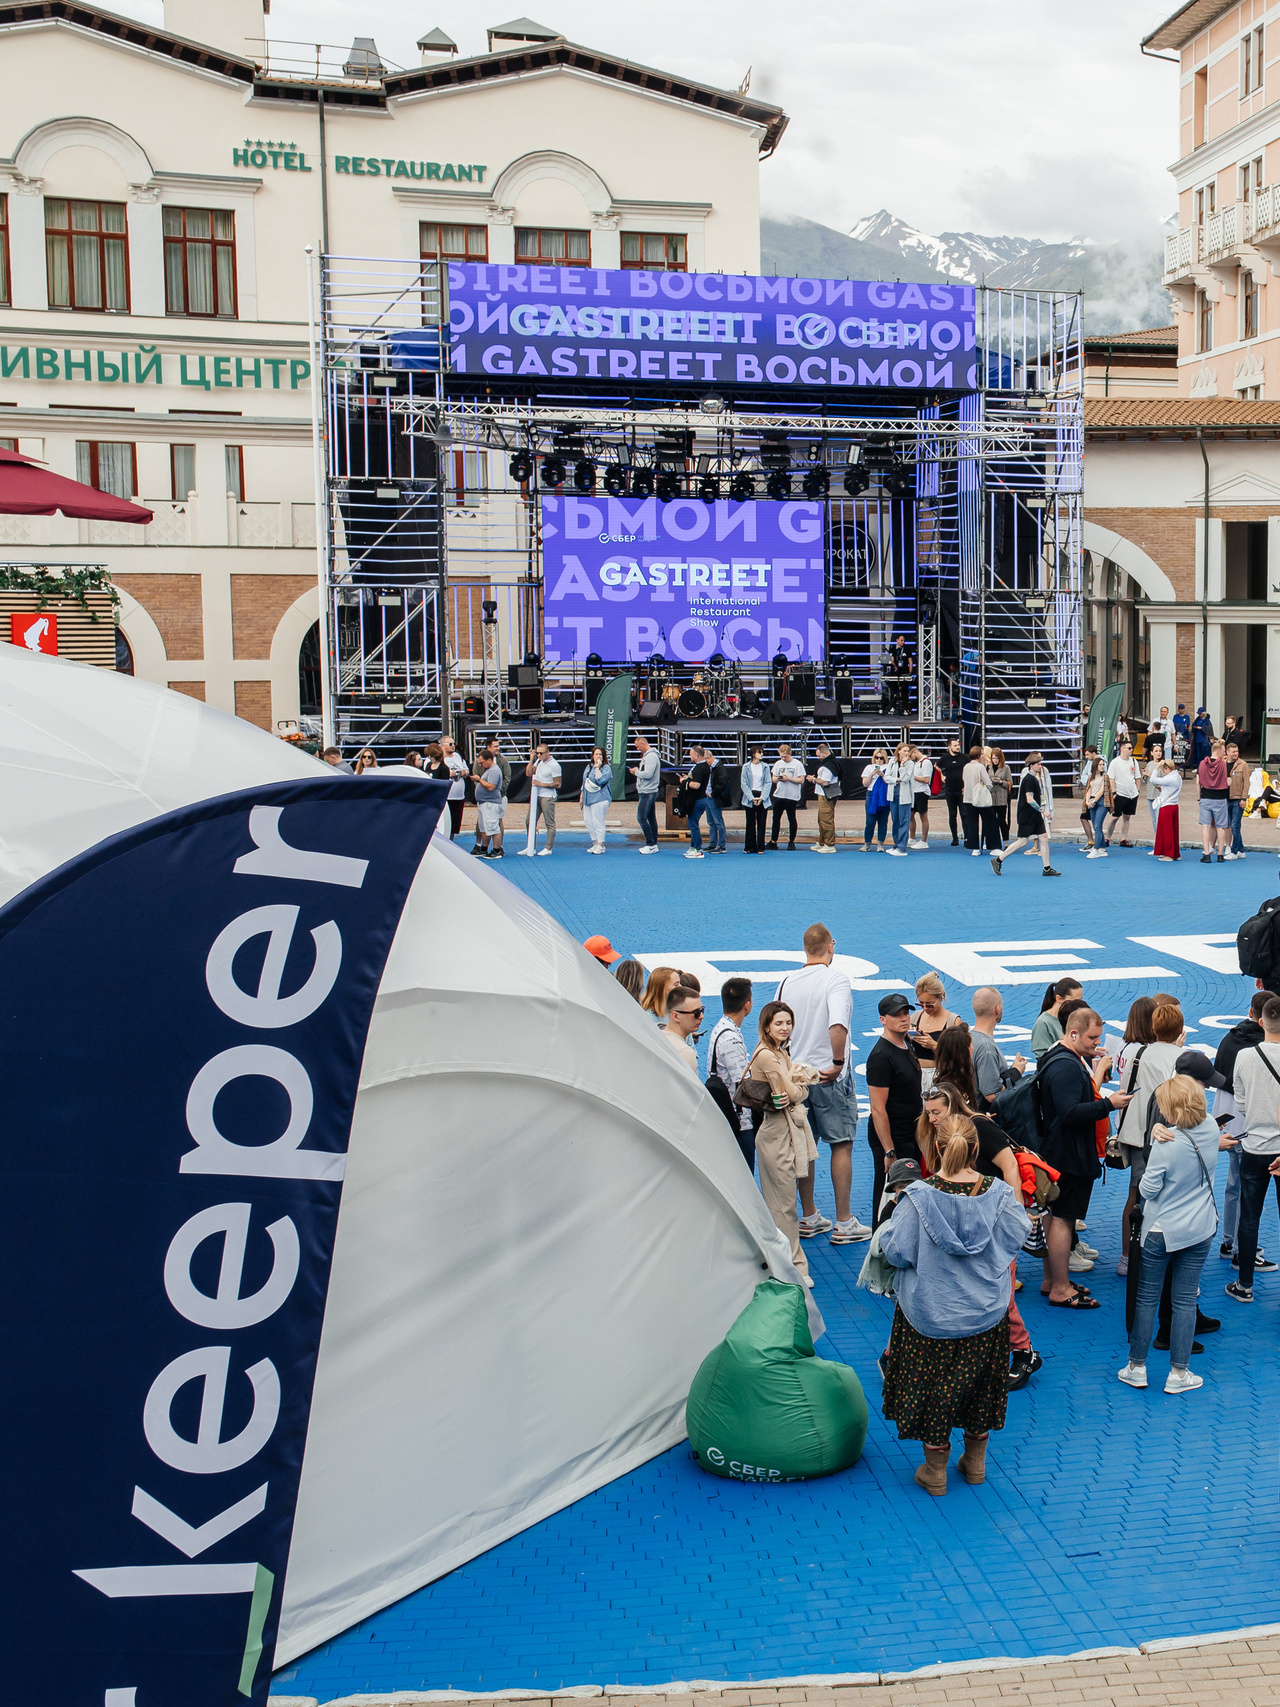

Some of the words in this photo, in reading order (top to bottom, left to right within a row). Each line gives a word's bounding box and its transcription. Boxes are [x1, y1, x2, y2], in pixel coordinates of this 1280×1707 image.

[233, 147, 312, 172] HOTEL
[335, 155, 487, 183] RESTAURANT
[180, 353, 311, 391] ЦЕНТР
[482, 345, 722, 381] GASTREET
[737, 352, 954, 388] ВОСЬМОЙ
[611, 535, 636, 543] СБЕР
[599, 562, 771, 587] GASTREET
[690, 596, 760, 606] International
[690, 607, 751, 617] Restaurant
[690, 618, 719, 627] Show
[606, 708, 615, 766] ОКОМПЛЕКС
[729, 1460, 781, 1477] СБЕР
